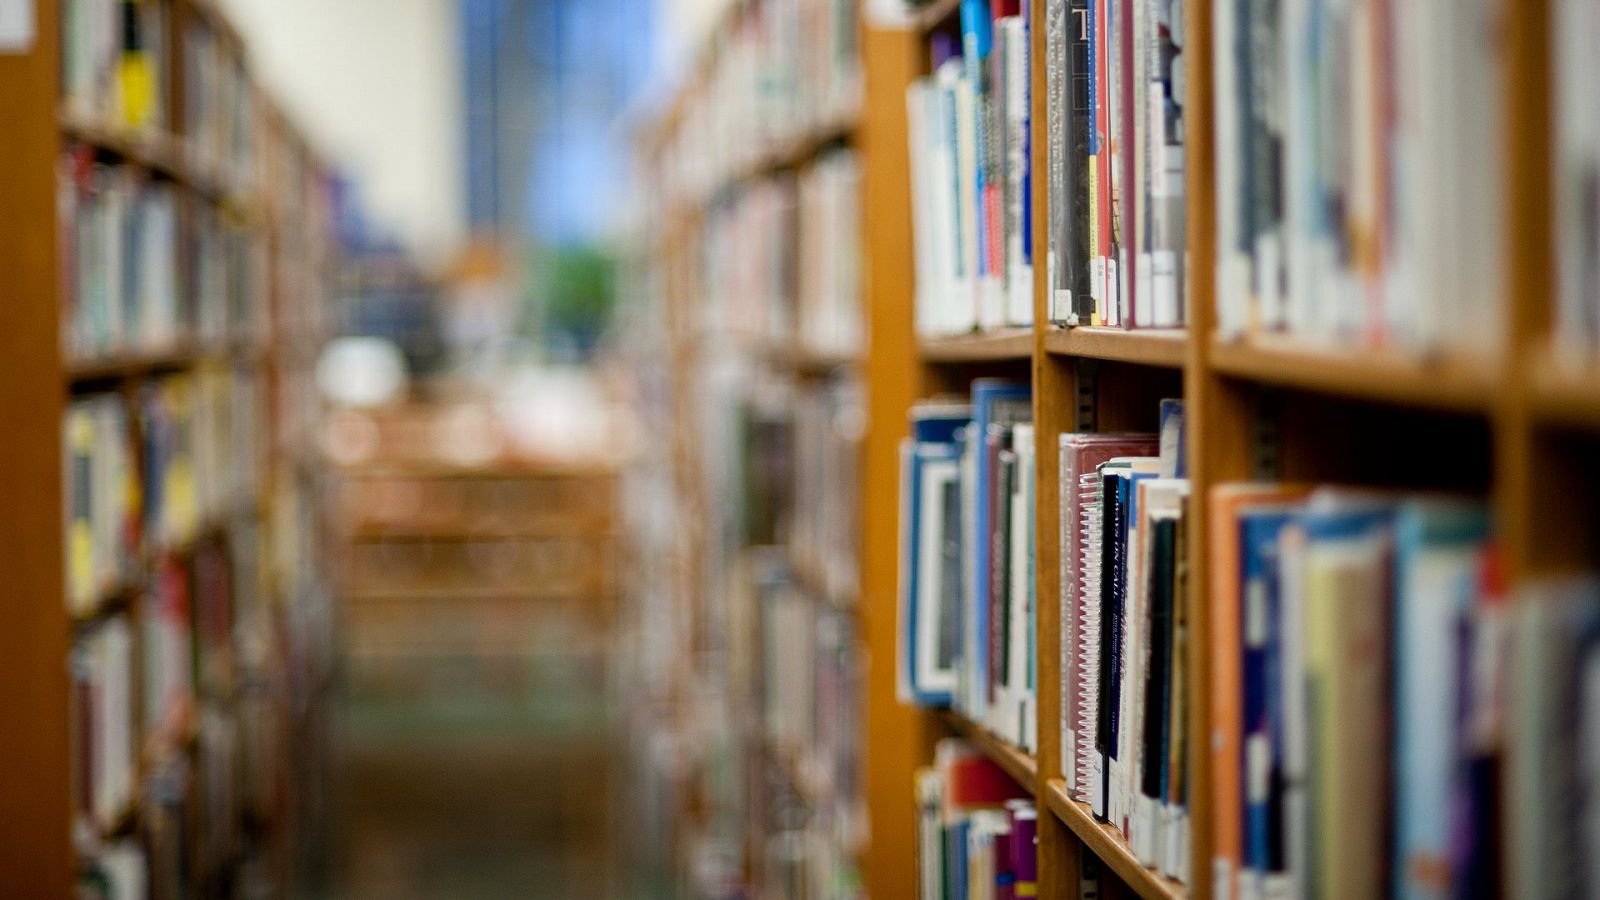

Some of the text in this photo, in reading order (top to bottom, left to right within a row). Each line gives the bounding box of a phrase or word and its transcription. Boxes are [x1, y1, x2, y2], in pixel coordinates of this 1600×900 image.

[1065, 465, 1073, 501] The
[1066, 506, 1074, 555] Care
[1065, 583, 1075, 669] Strangers
